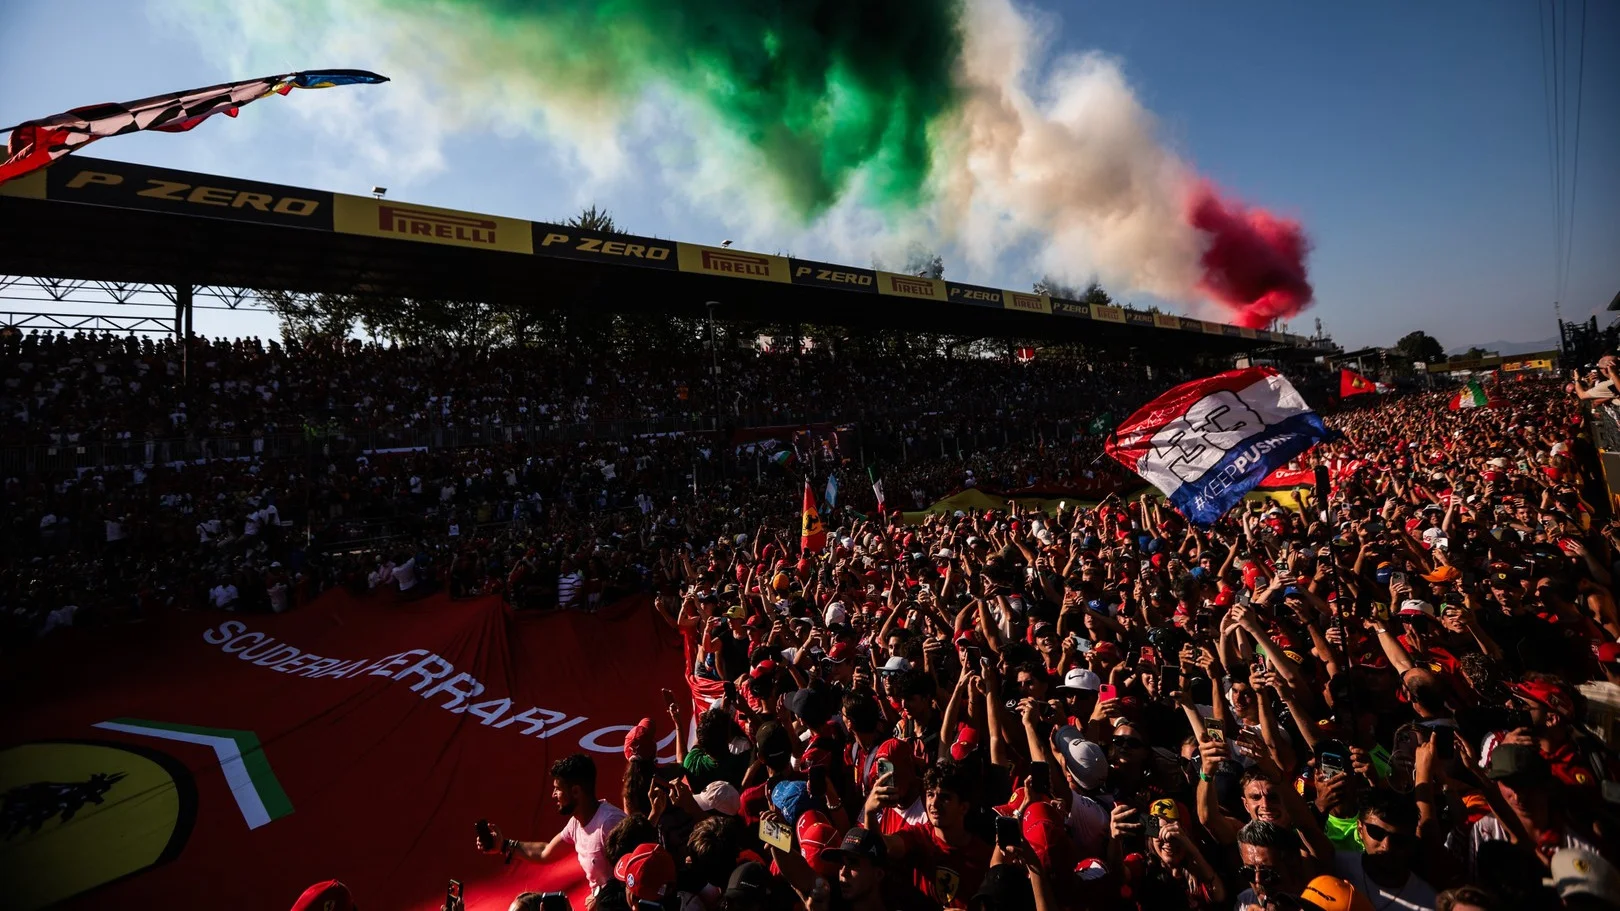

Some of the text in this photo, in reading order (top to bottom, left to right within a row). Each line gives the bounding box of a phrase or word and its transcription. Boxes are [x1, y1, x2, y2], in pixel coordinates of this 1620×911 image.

[64, 170, 320, 217] P ZERO
[379, 206, 497, 244] PIRELLI
[541, 232, 671, 261] P ZERO
[701, 250, 770, 277] PIRELLI
[795, 266, 873, 286] P ZERO
[891, 276, 935, 297] PIRELLI
[950, 287, 1000, 303] P ZERO
[1062, 303, 1089, 315] ZERO
[1150, 390, 1267, 484] 33
[203, 620, 369, 679] SCUDERIA
[346, 649, 589, 739] FERRARI
